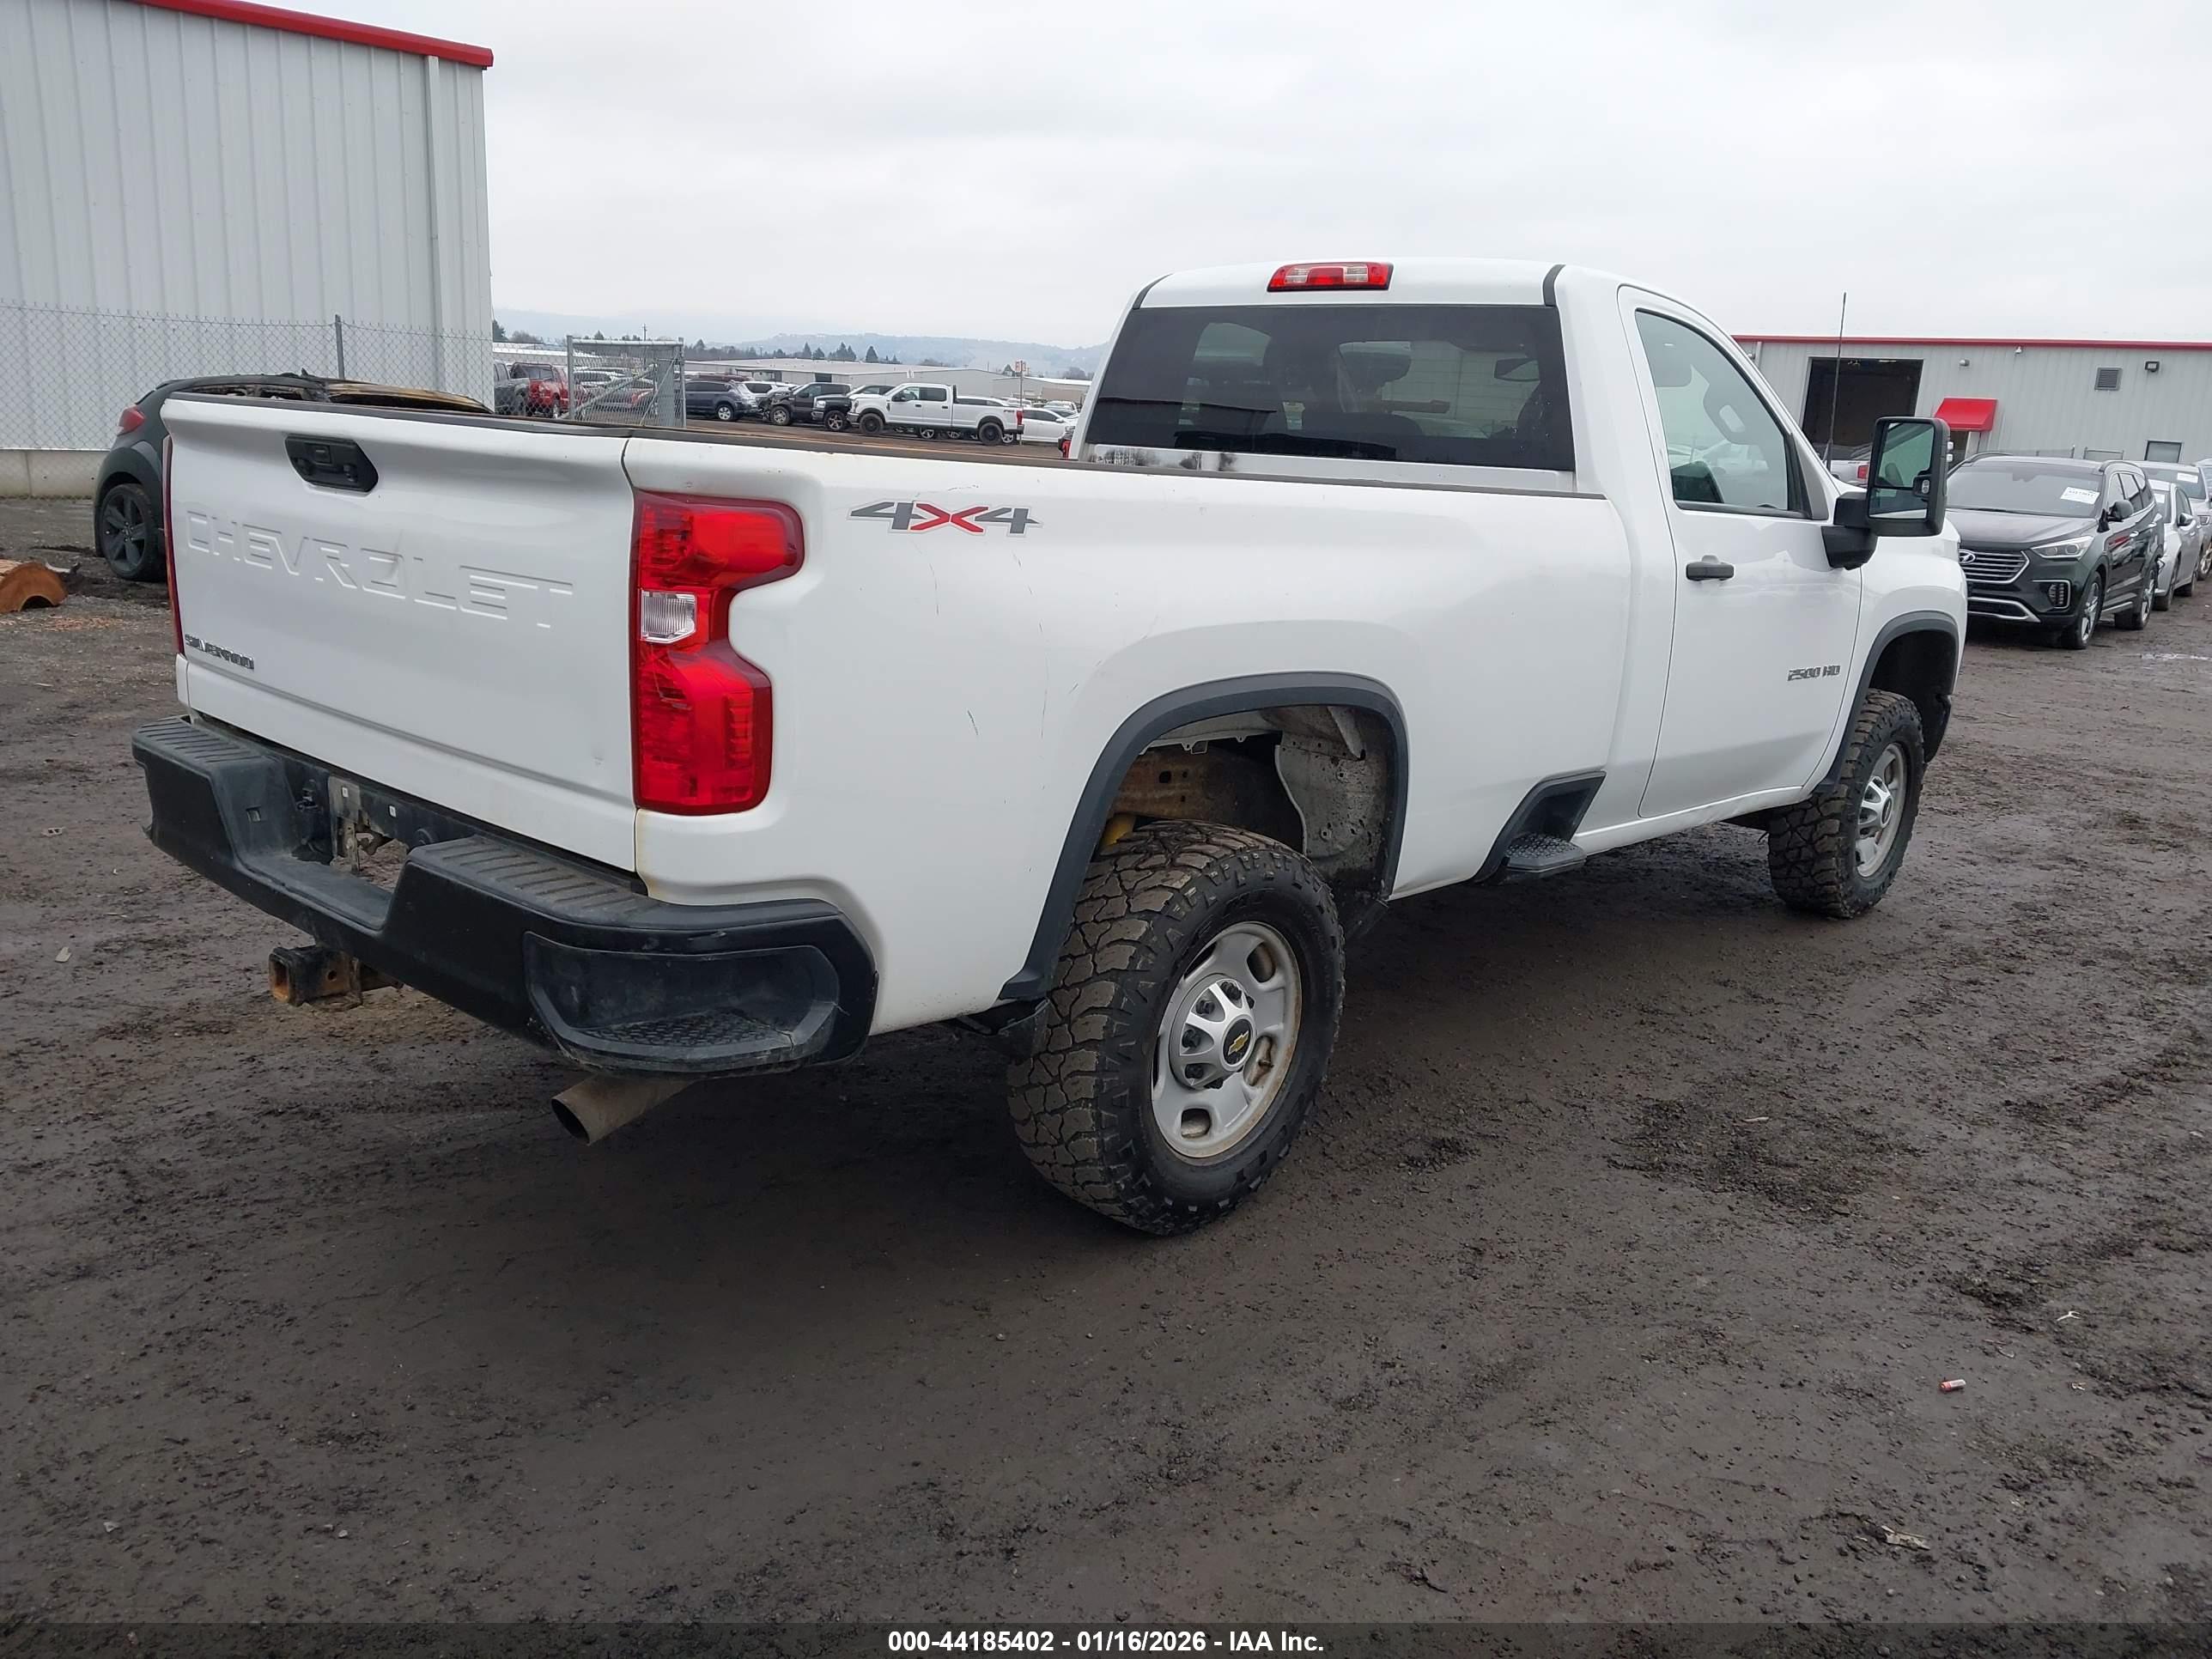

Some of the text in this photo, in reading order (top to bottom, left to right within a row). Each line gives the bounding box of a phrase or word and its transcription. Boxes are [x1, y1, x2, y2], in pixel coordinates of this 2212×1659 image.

[186, 509, 574, 629] CHEVROLET
[1787, 665, 1841, 681] 2500 HD
